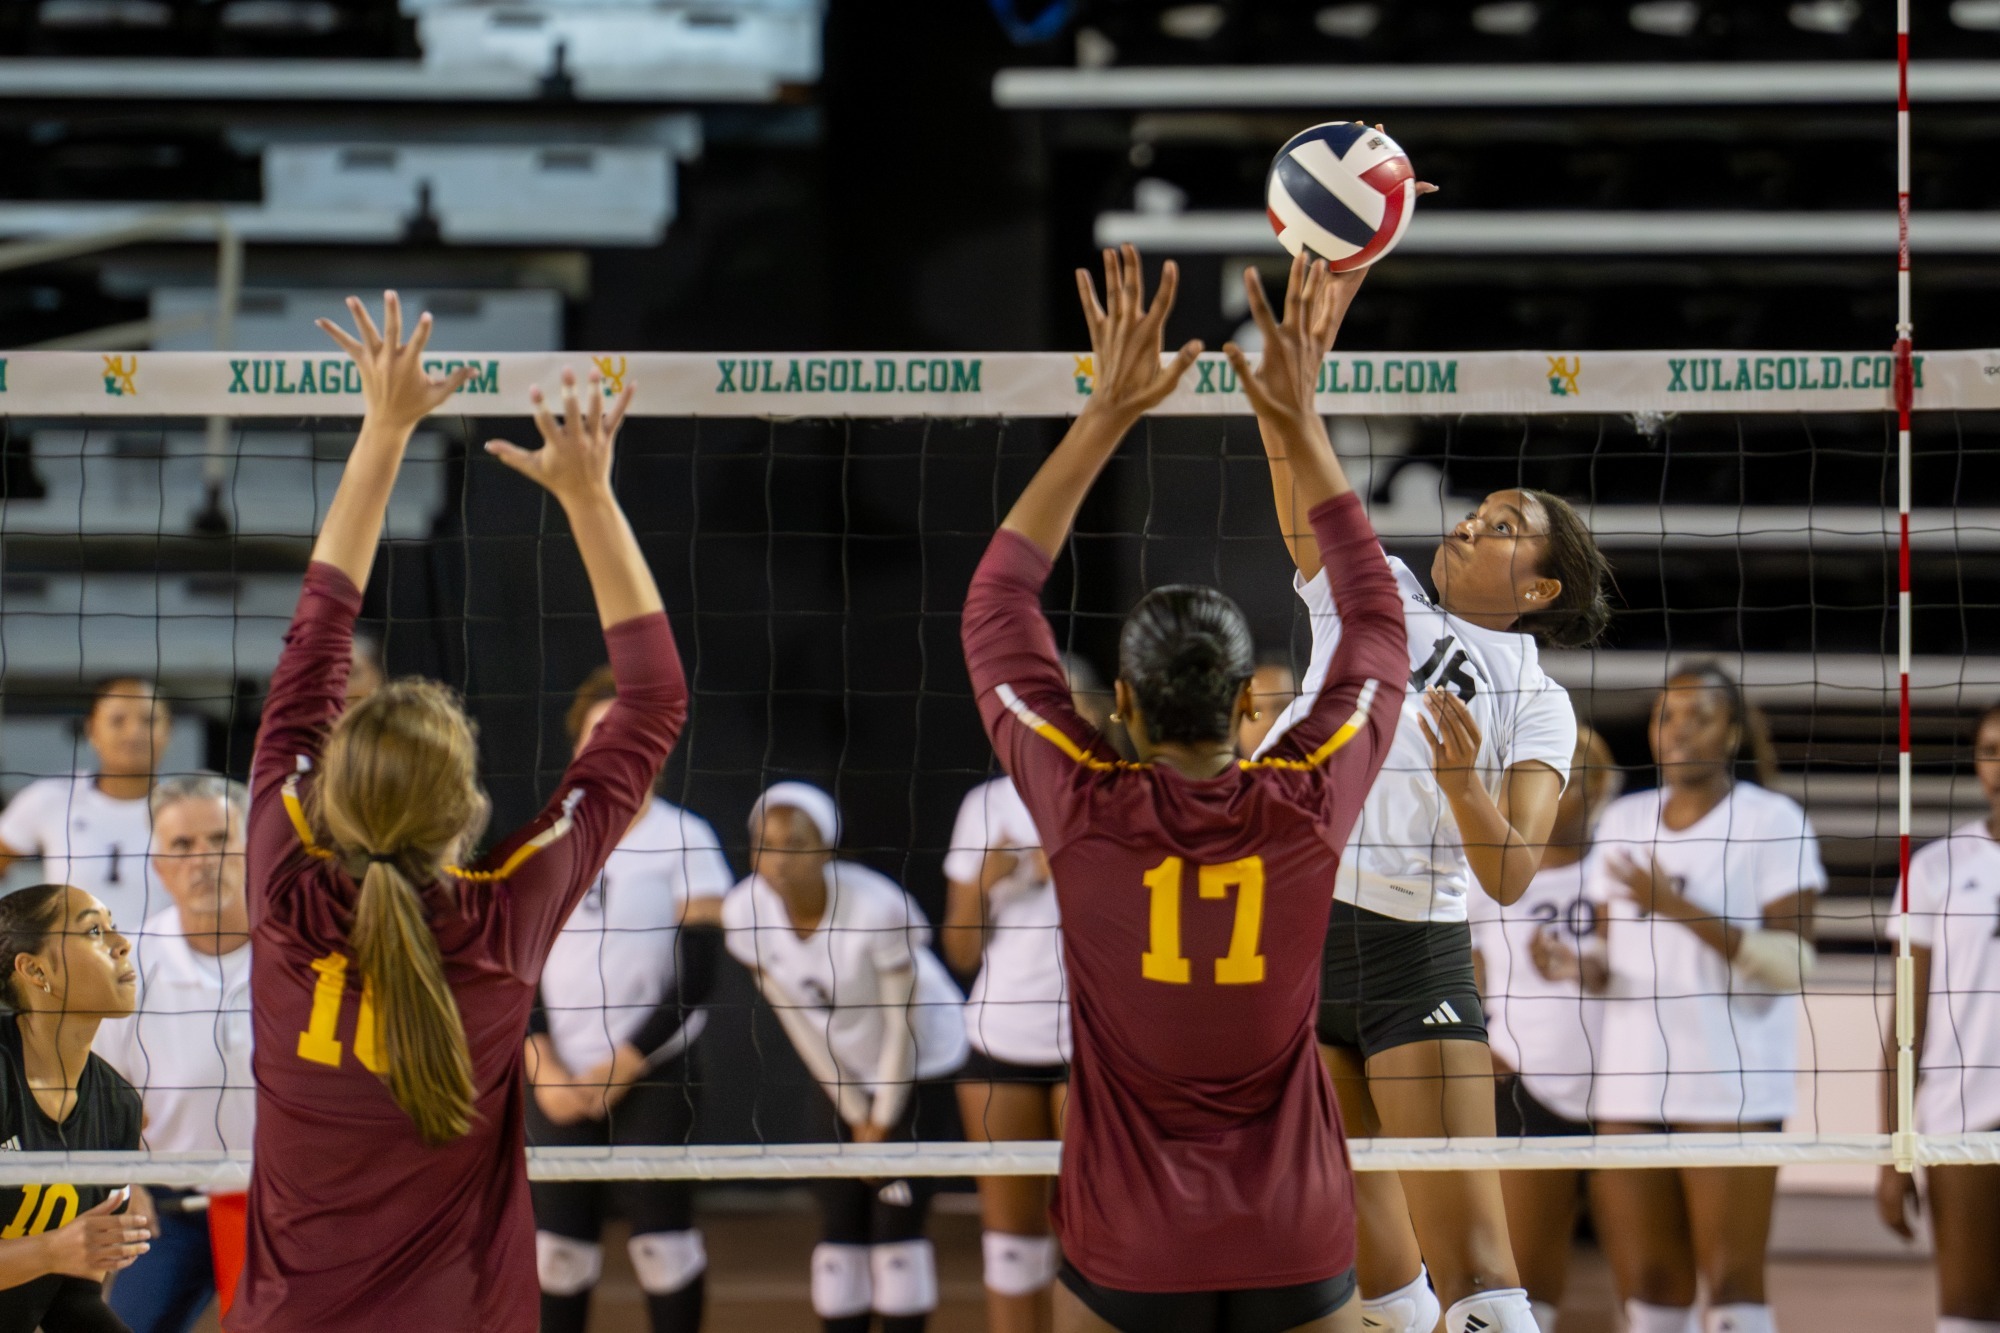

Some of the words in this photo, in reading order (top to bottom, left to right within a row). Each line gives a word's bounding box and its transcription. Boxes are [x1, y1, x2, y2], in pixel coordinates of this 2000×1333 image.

[228, 359, 499, 394] XULAGOOM
[715, 359, 982, 393] XULAGOLD.COM
[1195, 360, 1457, 394] XULD.COM
[1142, 854, 1266, 985] 17
[0, 1183, 79, 1240] 10
